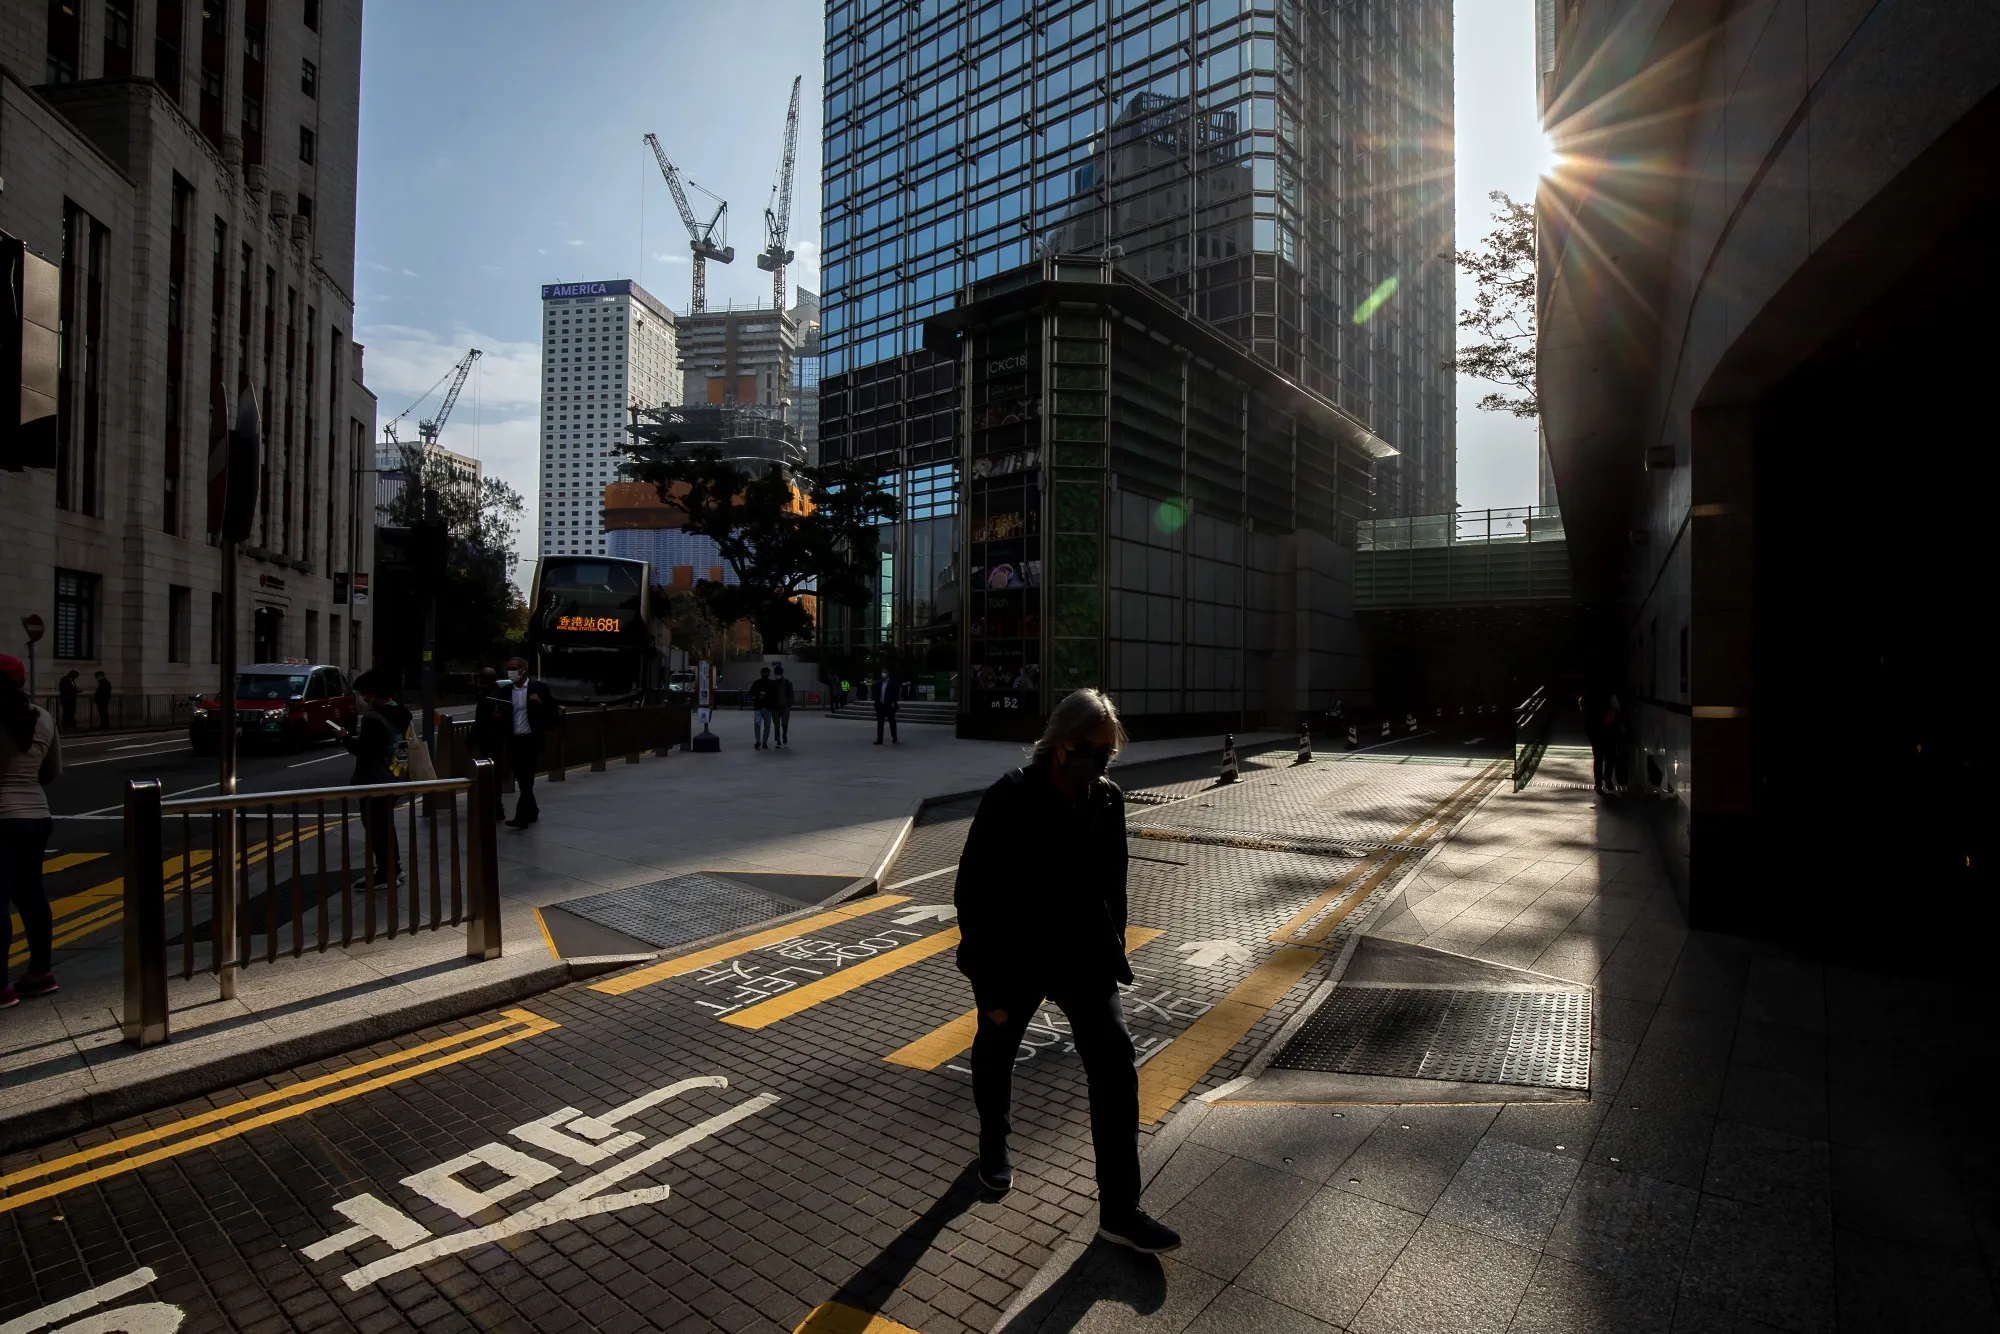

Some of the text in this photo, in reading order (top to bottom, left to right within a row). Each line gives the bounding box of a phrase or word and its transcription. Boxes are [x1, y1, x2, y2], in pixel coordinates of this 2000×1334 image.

[552, 283, 607, 297] AMERICA
[989, 354, 1026, 374] CKC18
[559, 616, 595, 628] 香港站
[597, 617, 620, 633] 681
[1003, 696, 1020, 708] B2
[694, 929, 923, 1016] LOOK LEFT
